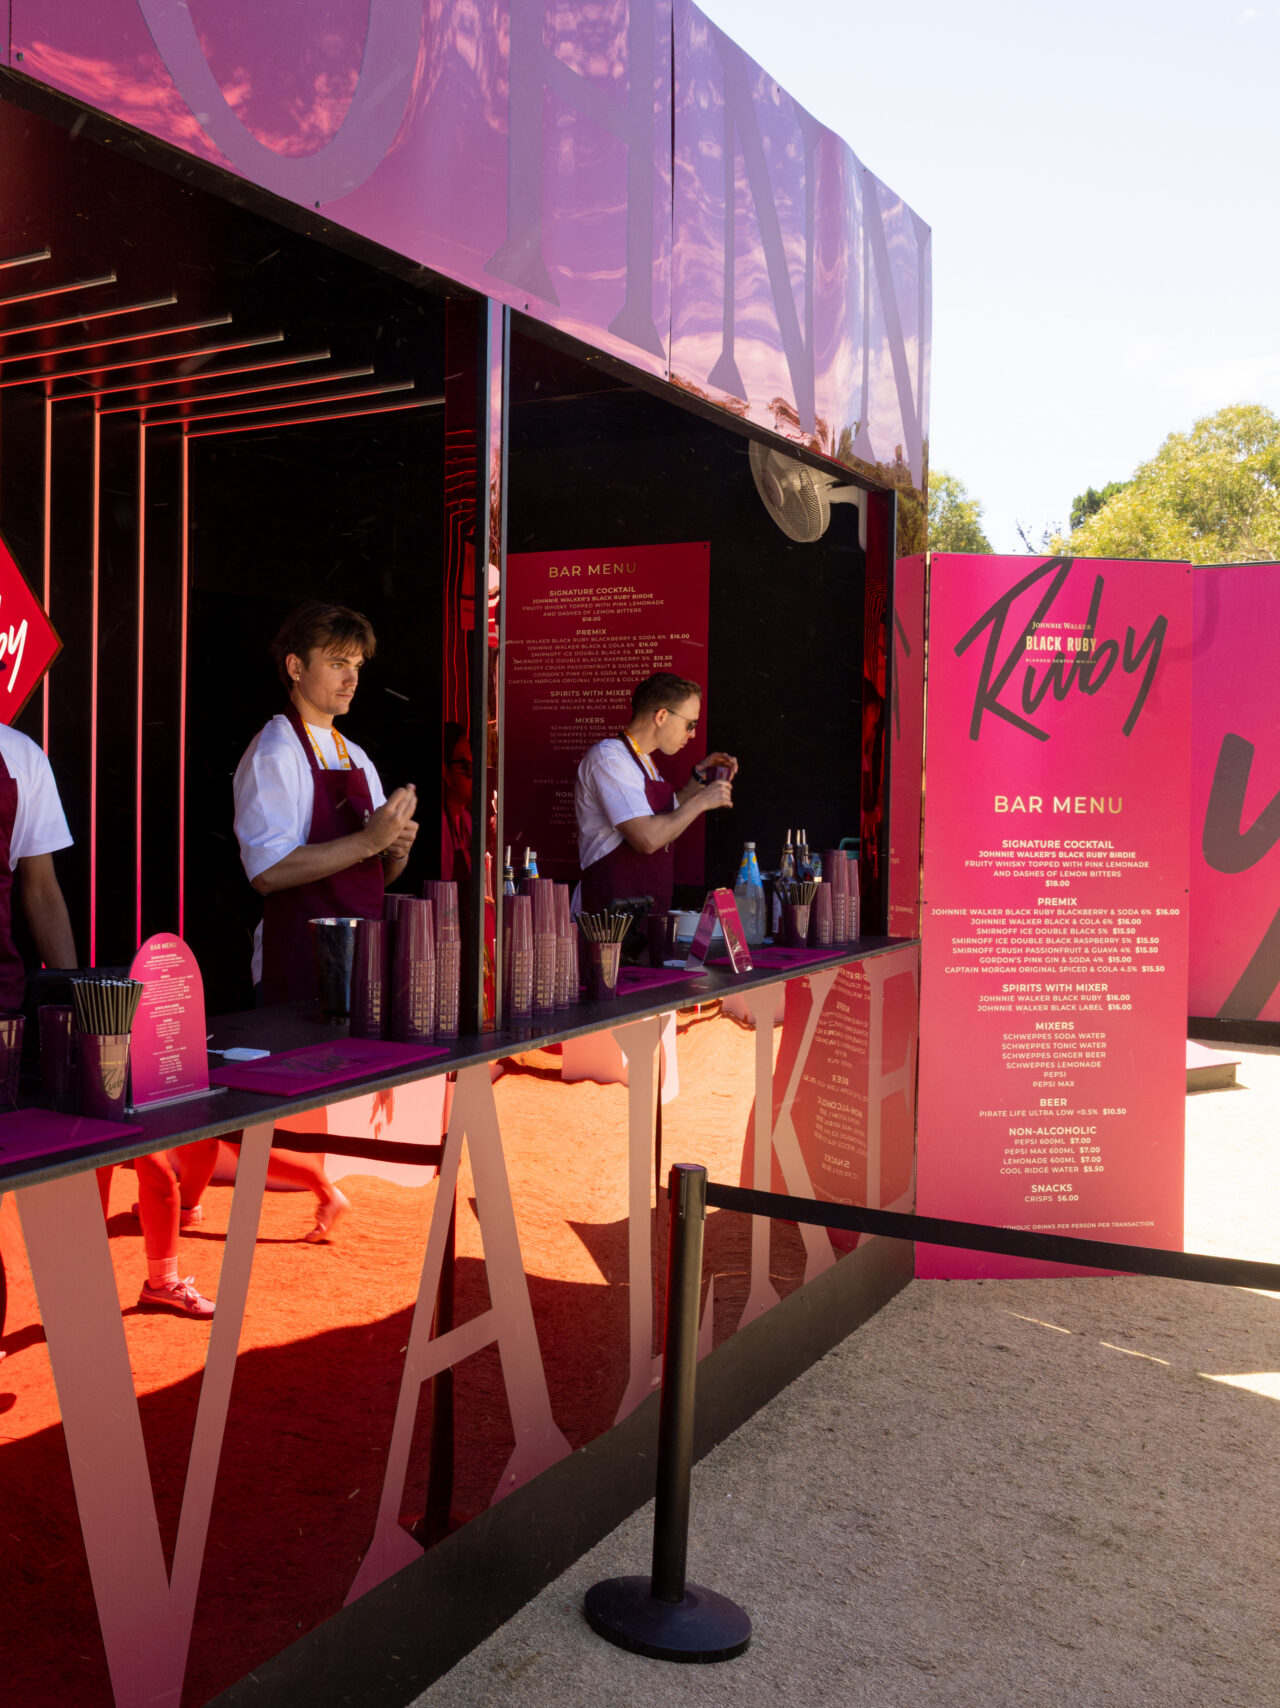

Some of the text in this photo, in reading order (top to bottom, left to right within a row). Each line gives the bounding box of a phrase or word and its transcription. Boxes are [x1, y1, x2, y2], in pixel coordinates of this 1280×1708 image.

[549, 562, 637, 578] BAR MENU
[549, 586, 636, 597] SIGNATURE COCKTAIL
[1032, 621, 1062, 630] JOHNNIE
[576, 628, 607, 636] PREMIX
[1025, 635, 1097, 652] BLACK RUBY
[954, 558, 1169, 742] Ruby
[994, 796, 1123, 815] BAR MENU
[1002, 840, 1114, 849] SIGNATURE COCKTAIL
[1038, 898, 1077, 906] PREMIX
[1002, 983, 1109, 992] SPIRITS WITH MIXER
[1035, 1022, 1074, 1030] MIXERS
[1006, 1061, 1054, 1069] SCHWEPPES
[1040, 1098, 1068, 1106] BEER
[1009, 1126, 1096, 1136] NON-ALCOHOLIC
[1003, 1157, 1048, 1165] LEMONADE
[1050, 1156, 1076, 1164] 600ML
[1000, 1167, 1021, 1175] COOL
[1024, 1166, 1049, 1174] RIDGE
[1083, 1165, 1104, 1173] $5.50
[1031, 1183, 1072, 1193] SNACKS
[1057, 1194, 1078, 1202] $6.00
